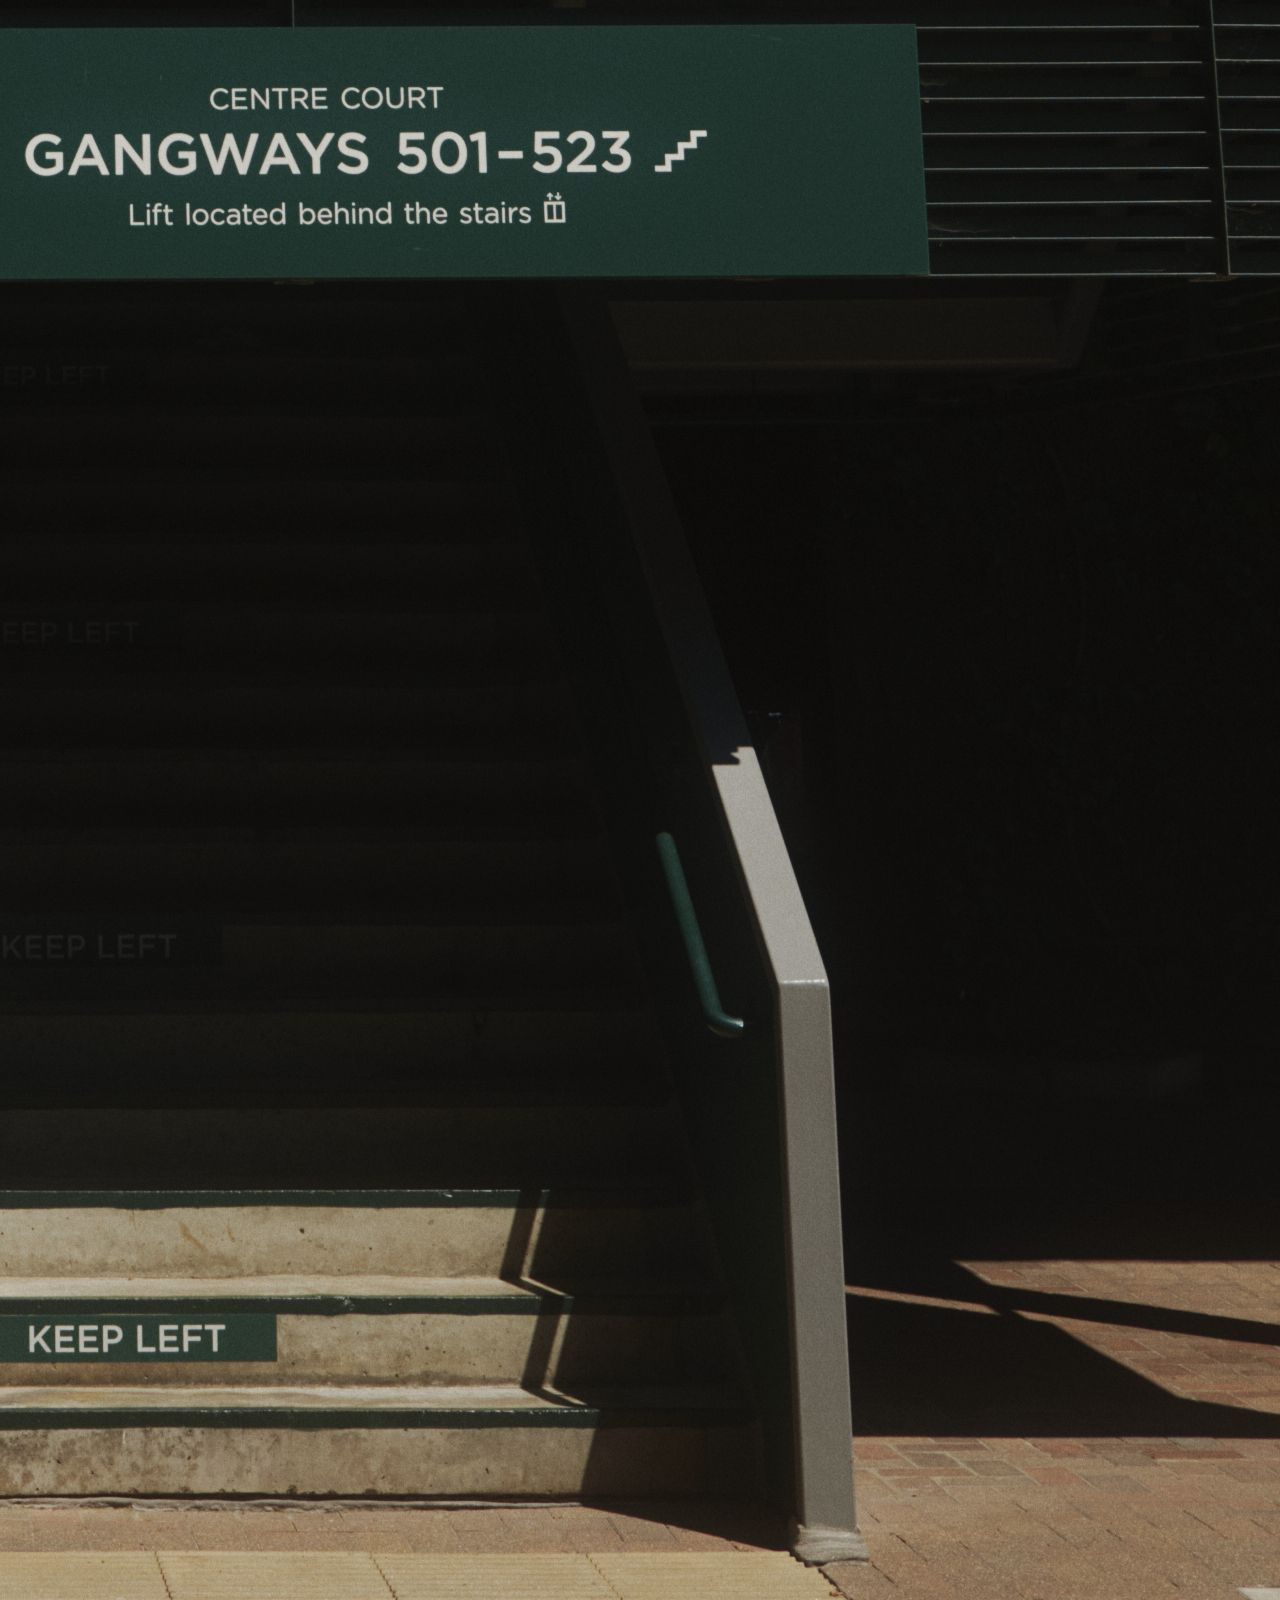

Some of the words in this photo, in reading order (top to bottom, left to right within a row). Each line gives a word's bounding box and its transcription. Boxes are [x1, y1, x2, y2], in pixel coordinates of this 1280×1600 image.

[209, 87, 329, 111] CENTRE
[340, 86, 444, 110] COURT
[24, 131, 369, 177] GANGWAYS
[129, 201, 174, 227] Lift
[185, 201, 287, 226] located
[298, 201, 393, 226] behind
[403, 201, 449, 225] the
[459, 201, 532, 225] stairs
[45, 364, 111, 384] LEFT
[67, 620, 140, 643] LEFT
[1, 933, 86, 960] KEEP
[97, 933, 177, 959] LEFT
[28, 1324, 124, 1354] KEEP
[136, 1323, 226, 1353] LEFT
